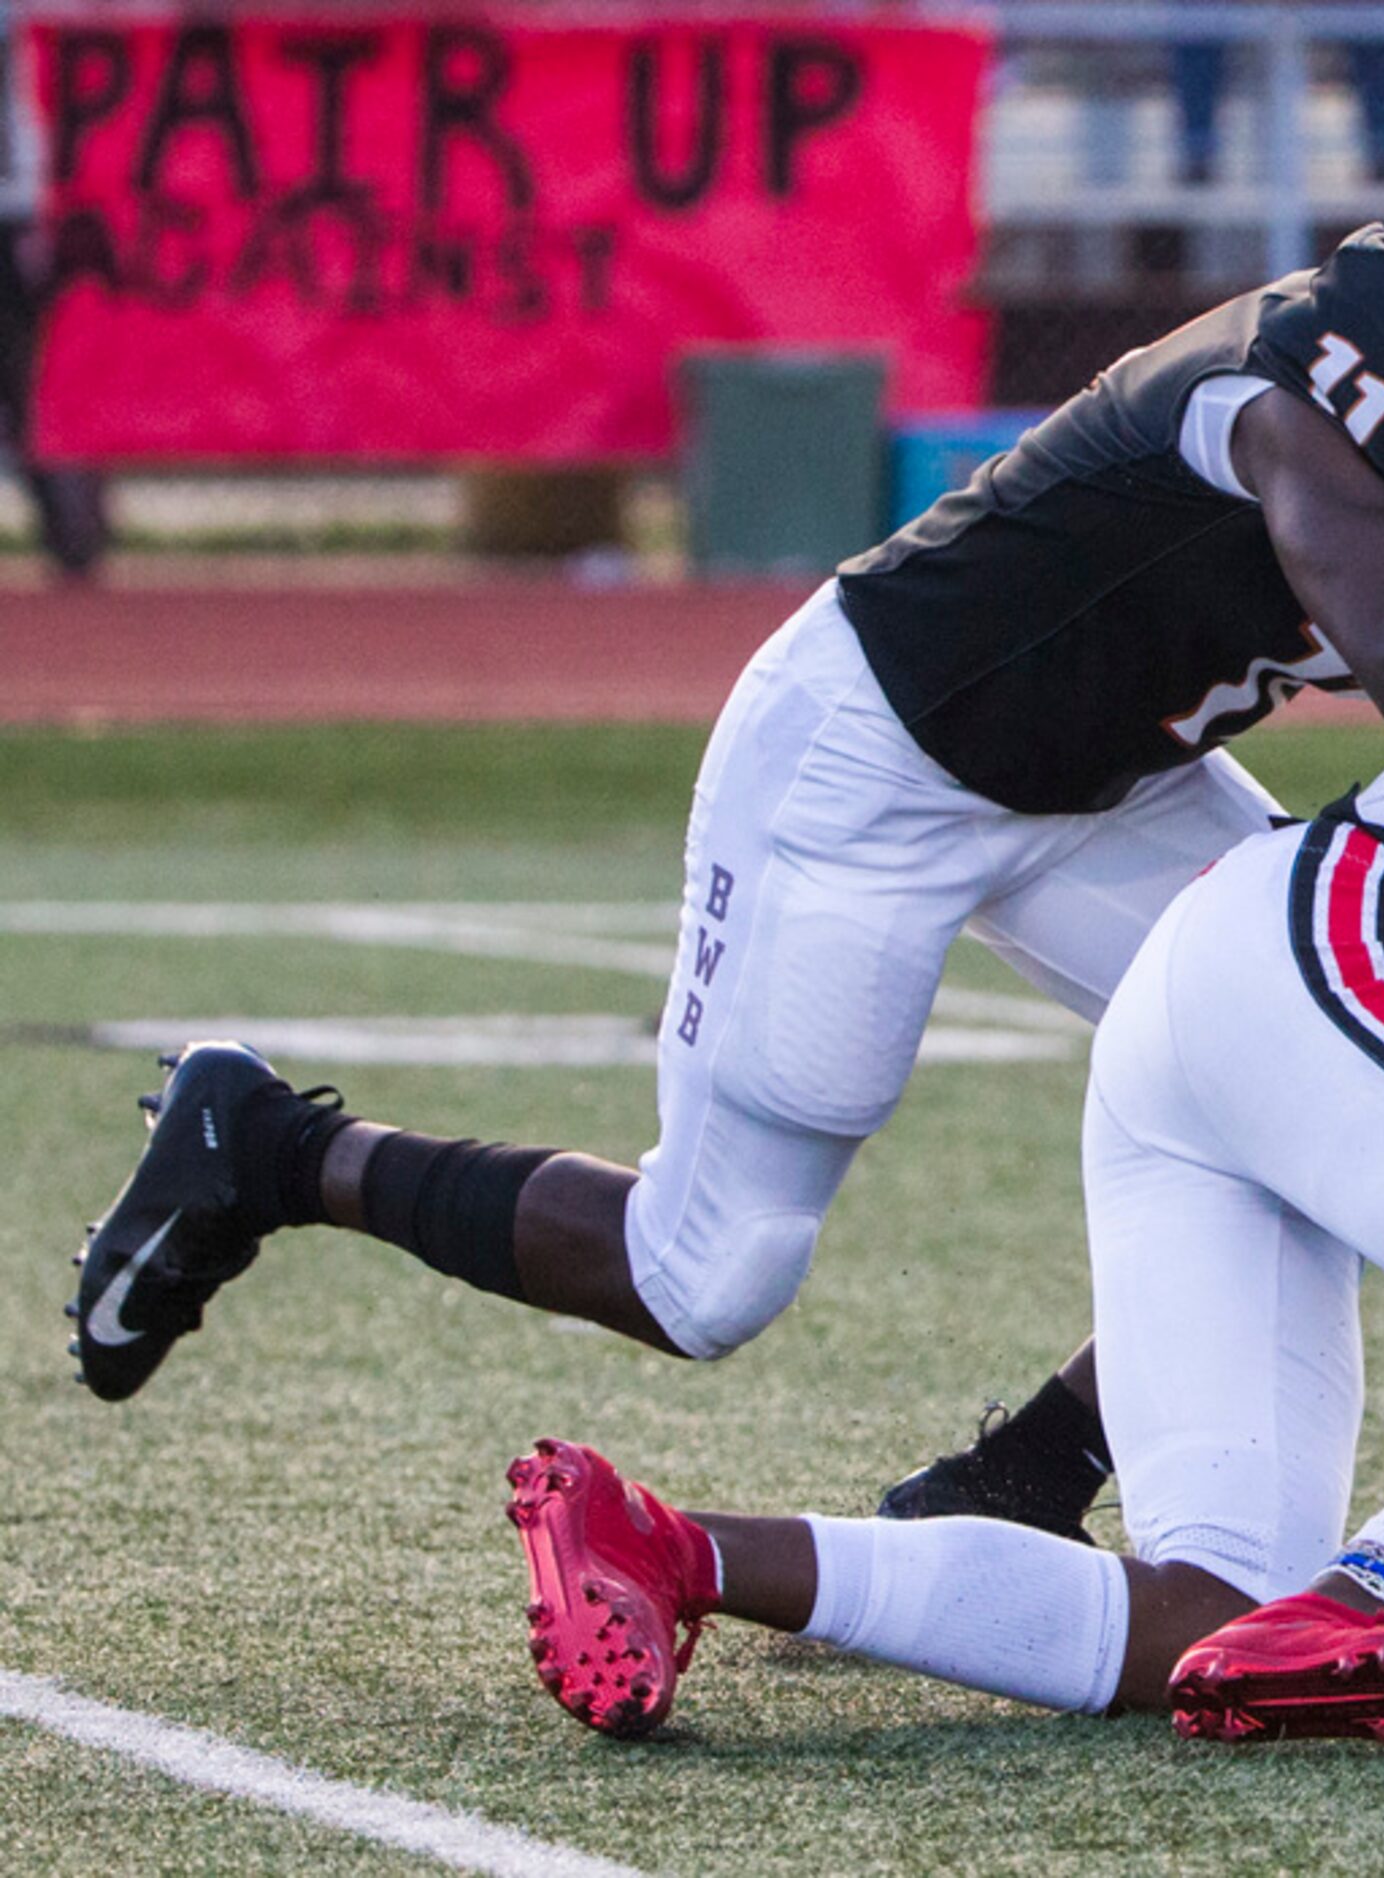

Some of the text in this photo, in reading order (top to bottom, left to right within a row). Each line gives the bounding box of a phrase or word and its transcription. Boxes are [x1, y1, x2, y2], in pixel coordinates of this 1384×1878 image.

[55, 22, 866, 212] PAIR UP
[45, 200, 618, 324] AGAINST
